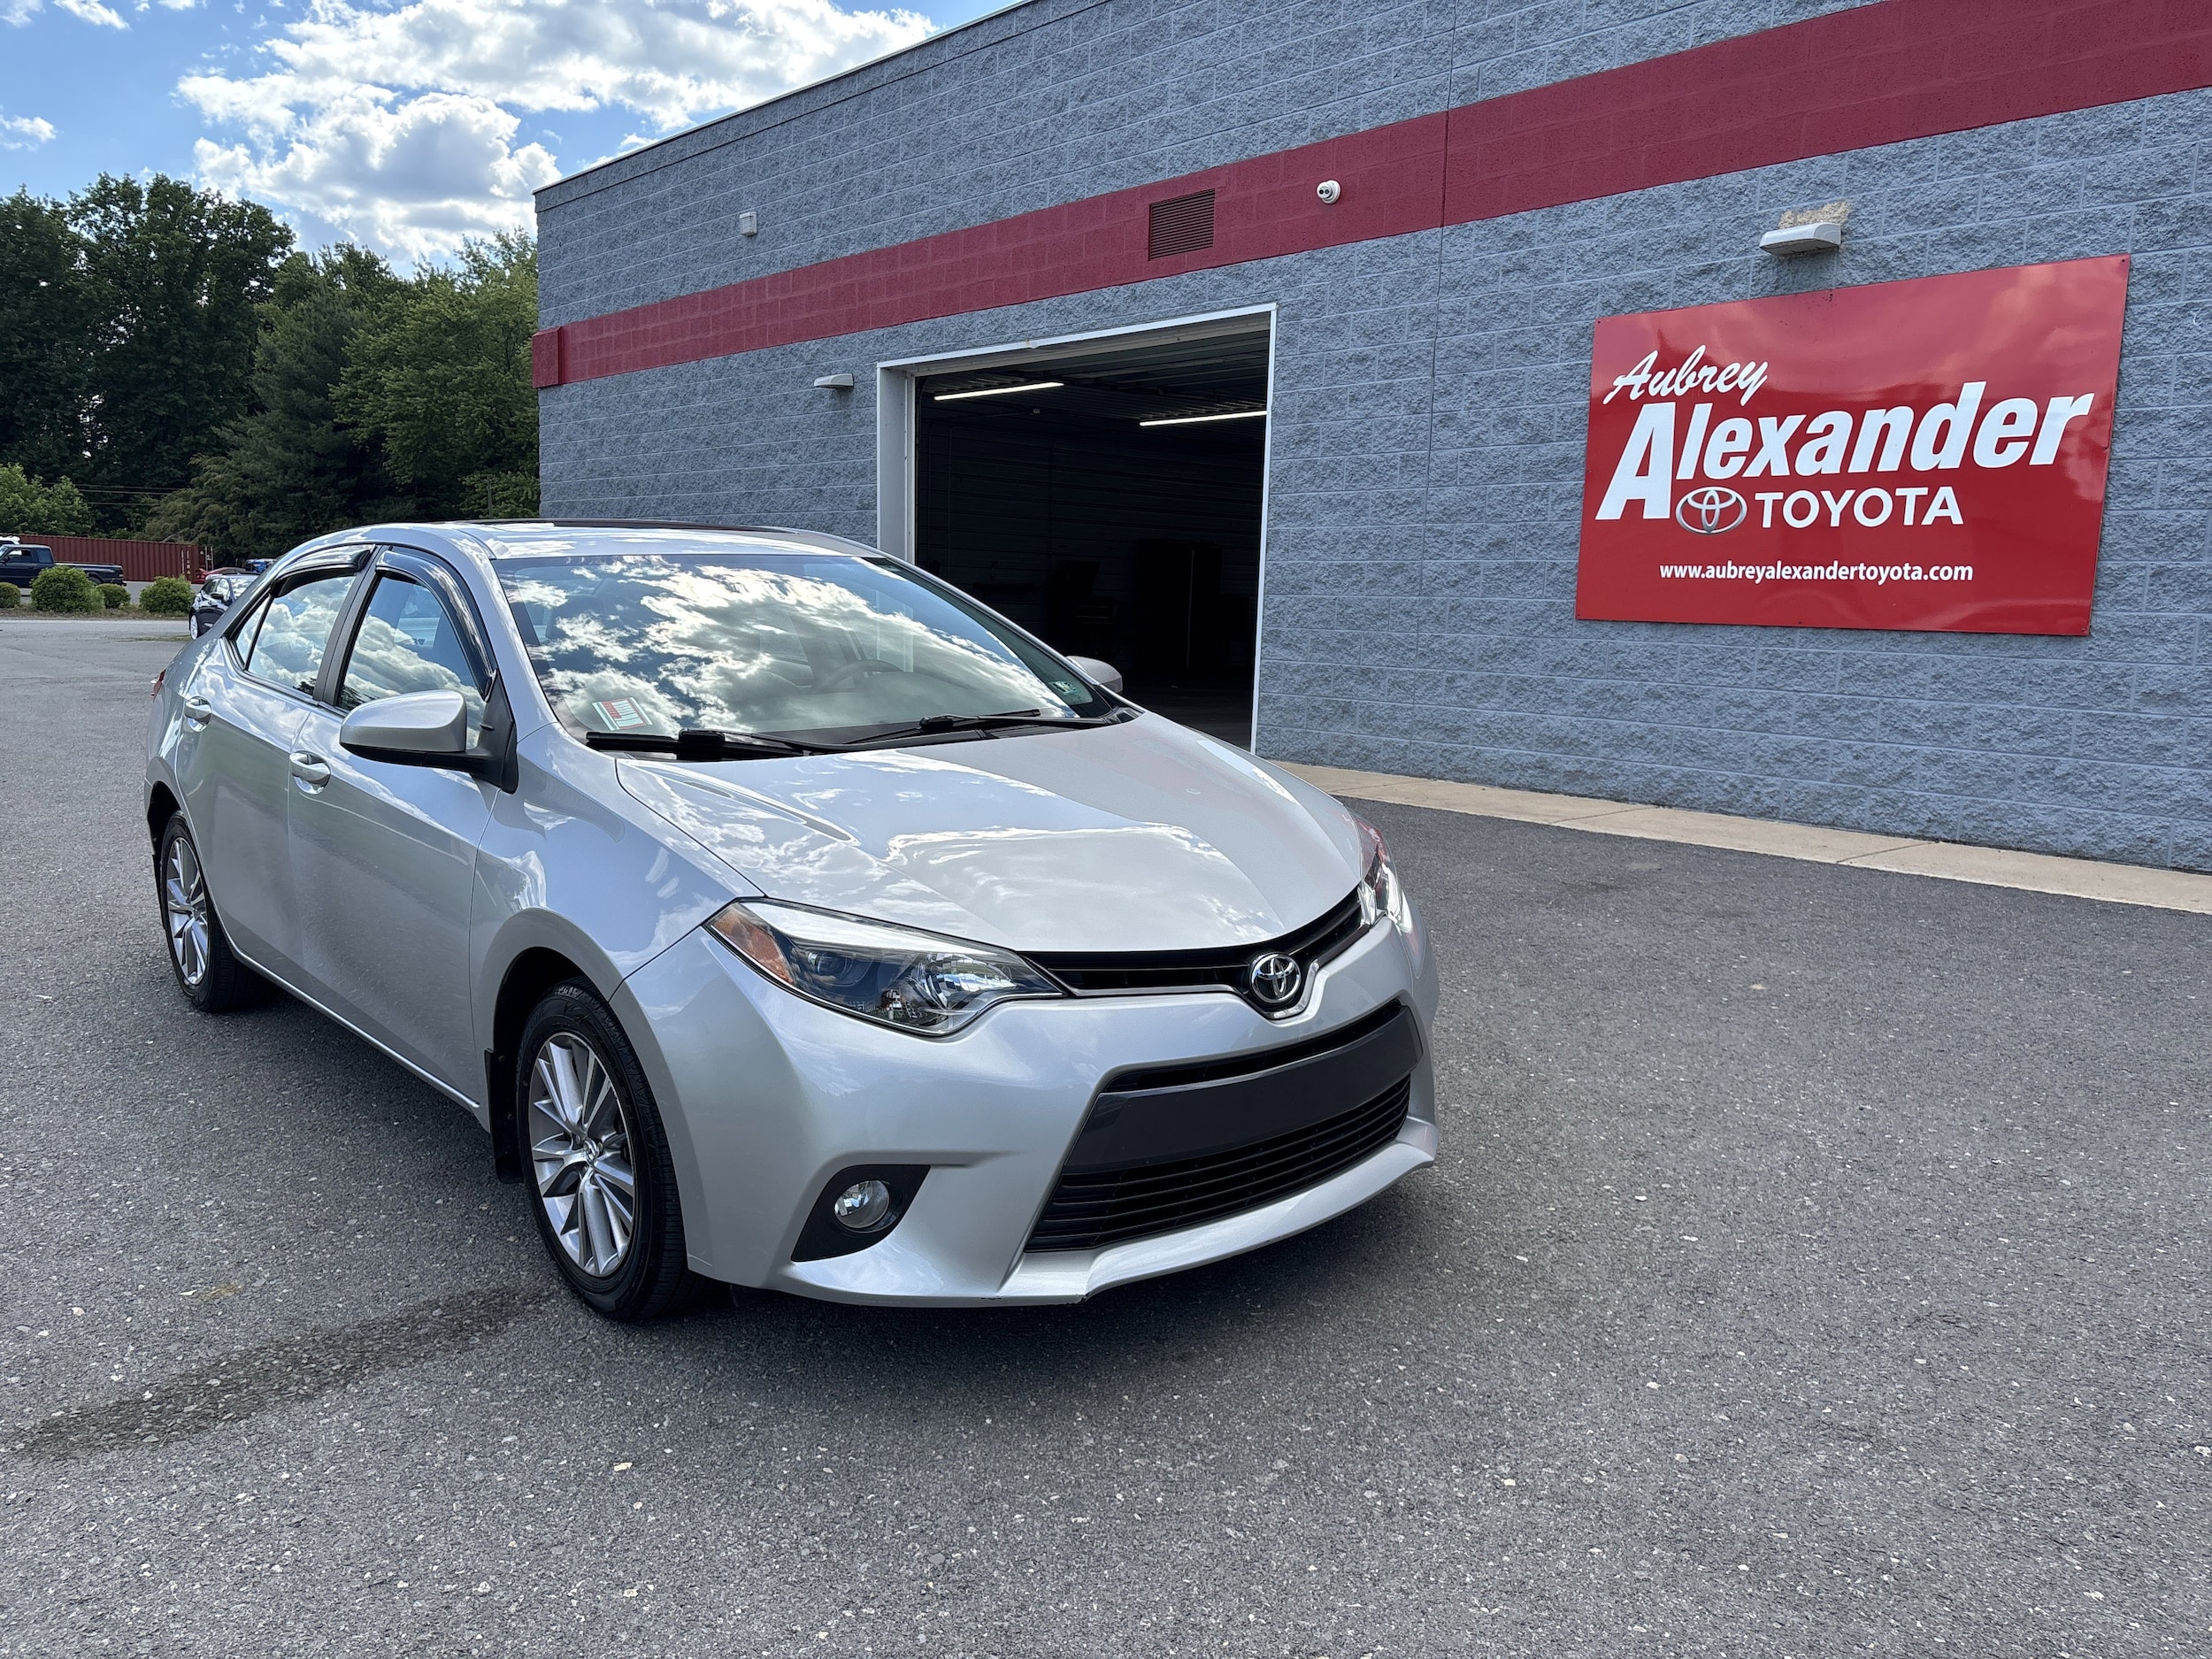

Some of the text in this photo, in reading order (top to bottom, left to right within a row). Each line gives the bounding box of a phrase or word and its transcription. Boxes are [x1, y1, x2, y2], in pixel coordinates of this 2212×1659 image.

[1602, 344, 1769, 406] Aubrey
[1595, 380, 2095, 520] Alexander
[1755, 486, 1964, 529] TOYOTA
[1659, 560, 1974, 586] www.aubreyalexandertoyota.com
